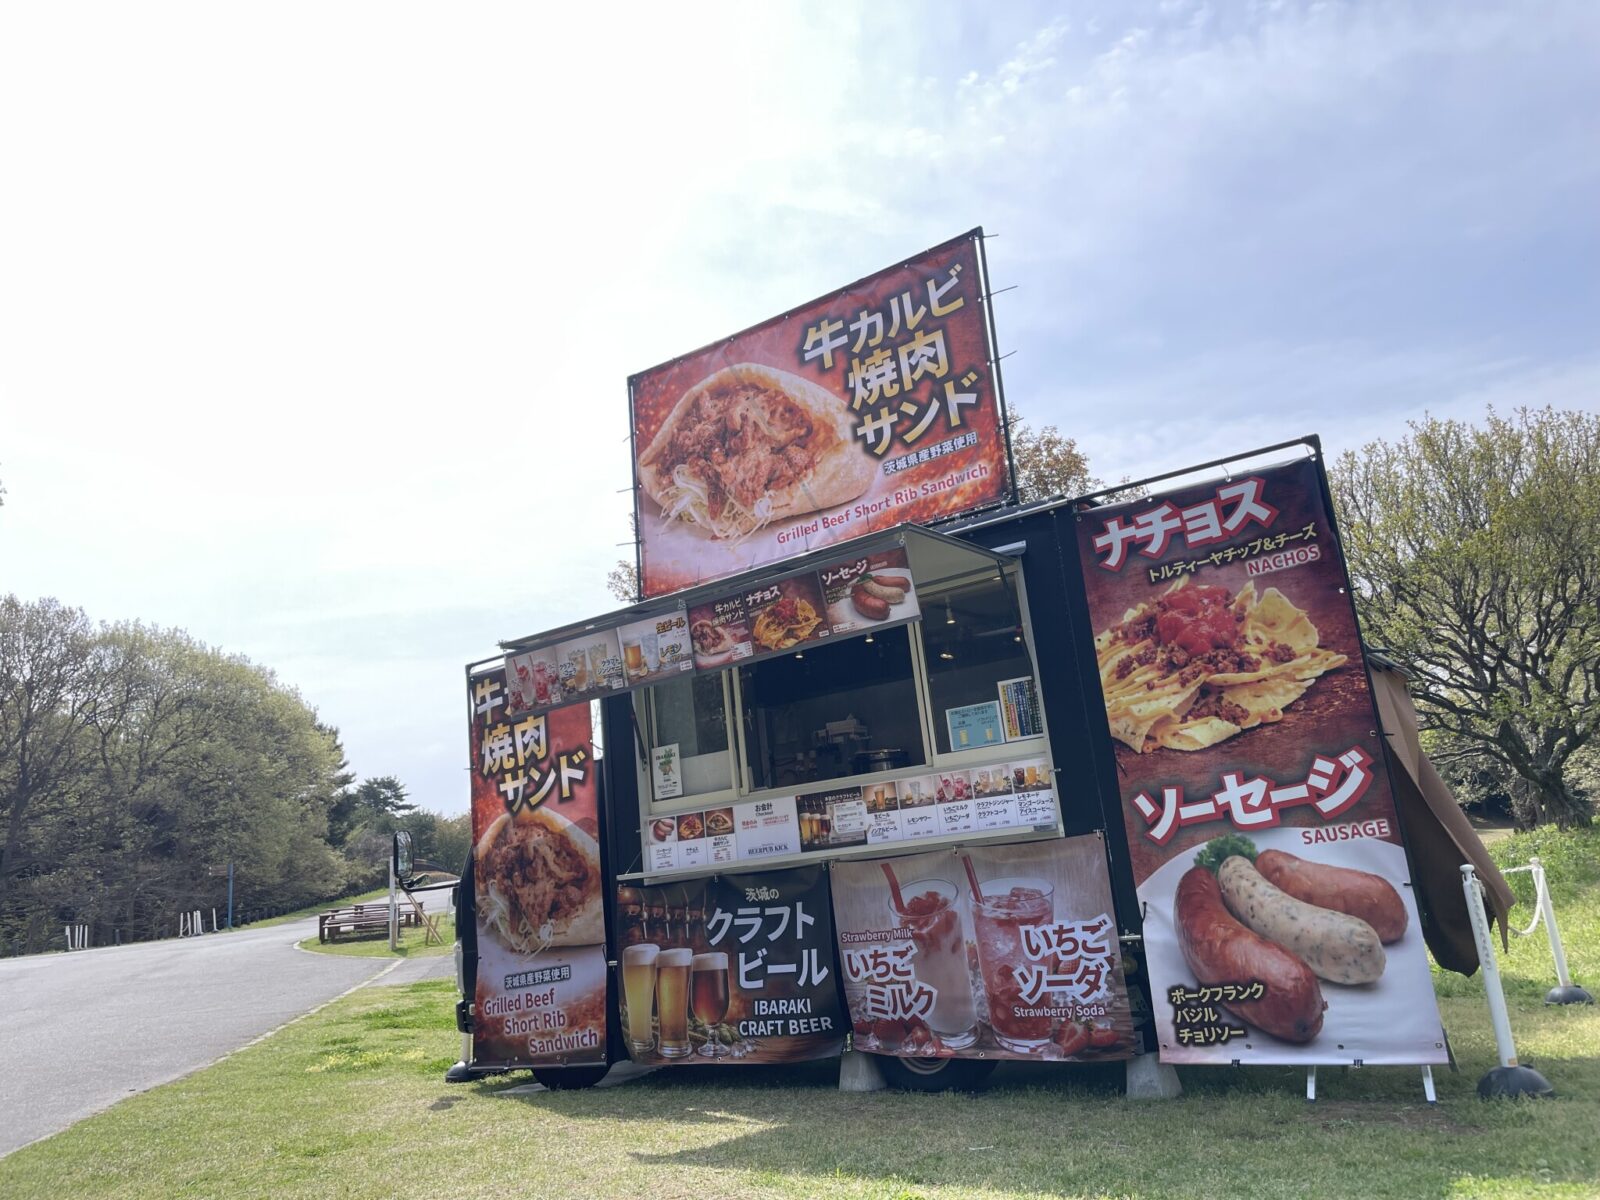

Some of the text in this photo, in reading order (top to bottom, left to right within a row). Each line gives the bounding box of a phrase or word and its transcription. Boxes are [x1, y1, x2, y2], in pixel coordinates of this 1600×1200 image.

[803, 263, 965, 369] 牛カルビ
[848, 329, 948, 410] 焼肉
[856, 371, 978, 455] サンド
[884, 432, 977, 474] 茨城県産野菜使用
[777, 463, 989, 545] Grilled Beef Short Rib Sandwich
[1095, 481, 1272, 567] ナチョス
[1150, 521, 1317, 582] トルティーヤチップ&チーズ
[1248, 547, 1320, 575] NACHOS
[822, 559, 867, 585] ソーセージ
[746, 586, 781, 606] ナチョス
[482, 715, 547, 776] 焼肉
[499, 750, 586, 812] サンド
[1134, 750, 1364, 840] ソーセージ
[1301, 820, 1390, 845] SAUSAGE
[745, 886, 780, 902] 茨城の
[706, 901, 815, 946] クラフト
[841, 928, 913, 943] Strawberry Milk
[1023, 915, 1112, 960] いちご
[737, 947, 829, 989] ビール
[846, 942, 916, 980] いちご
[505, 967, 570, 989] 茨城県産野菜使用
[1015, 962, 1109, 1005] ソーダ
[1171, 982, 1265, 1005] ポークフランク
[484, 988, 555, 1016] Grilled Beef
[754, 998, 812, 1016] IBARAKI
[867, 984, 936, 1018] ミルク
[1014, 1004, 1105, 1018] Strawberry Soda
[1176, 1007, 1218, 1024] バジル
[505, 1011, 566, 1035] Short Rib
[739, 1016, 834, 1036] CRAFT BEER
[1179, 1027, 1245, 1044] チョリソー
[529, 1029, 598, 1054] Sandwich
